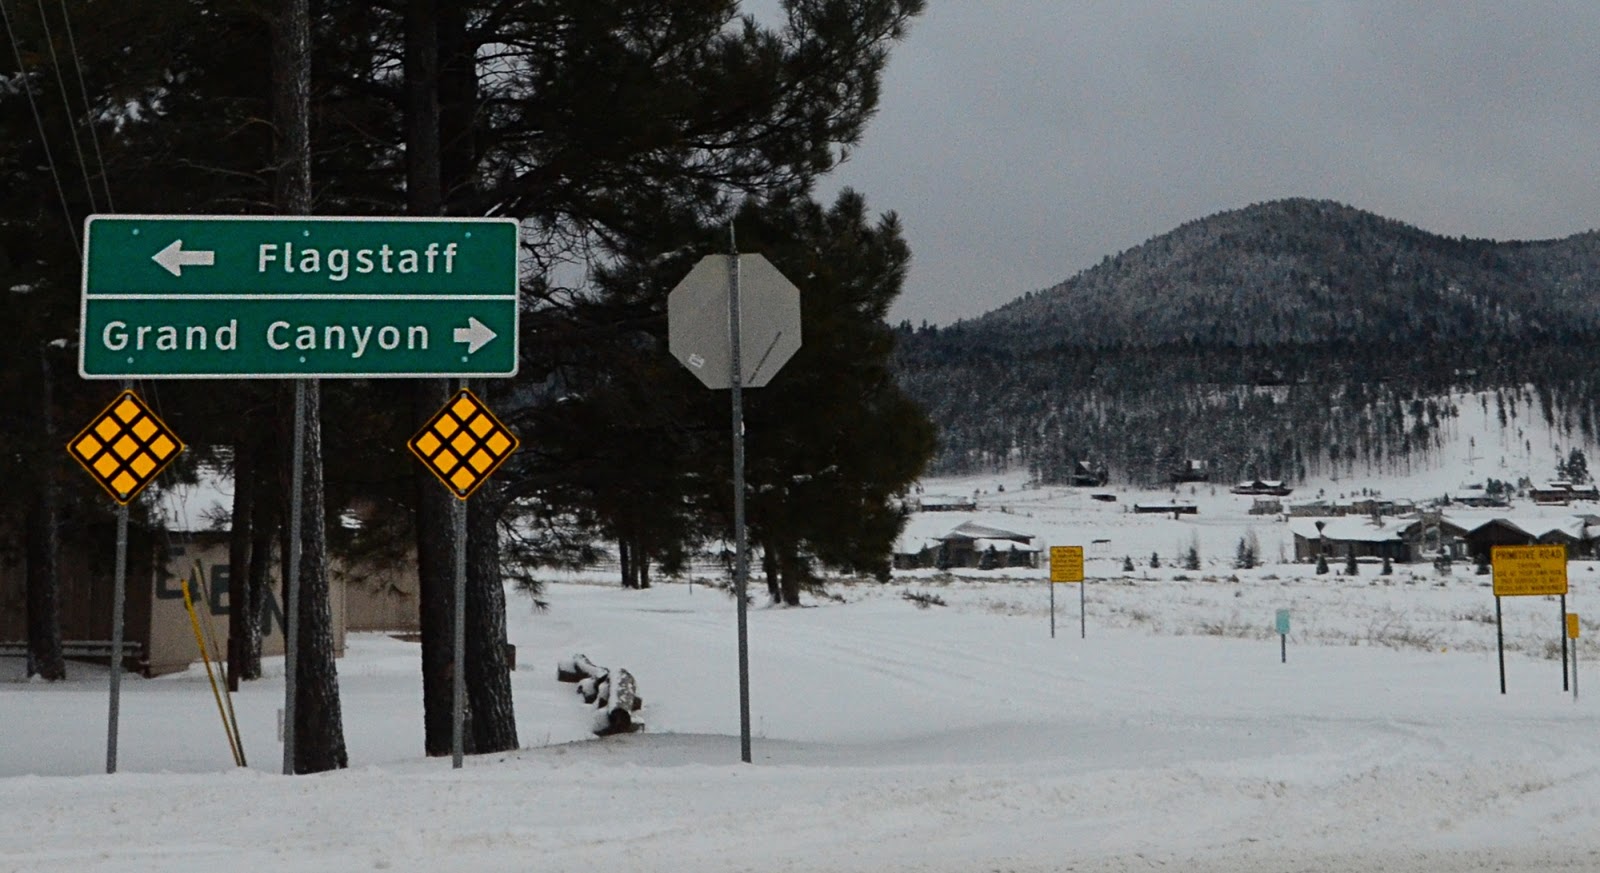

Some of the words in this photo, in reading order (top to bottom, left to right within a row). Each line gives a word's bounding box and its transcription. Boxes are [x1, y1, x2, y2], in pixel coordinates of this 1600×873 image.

[257, 242, 457, 281] Flagstaff
[102, 319, 239, 352] Grand
[266, 321, 430, 360] Canyon
[1496, 550, 1535, 560] PRIMITIVE
[1539, 549, 1562, 559] ROAD
